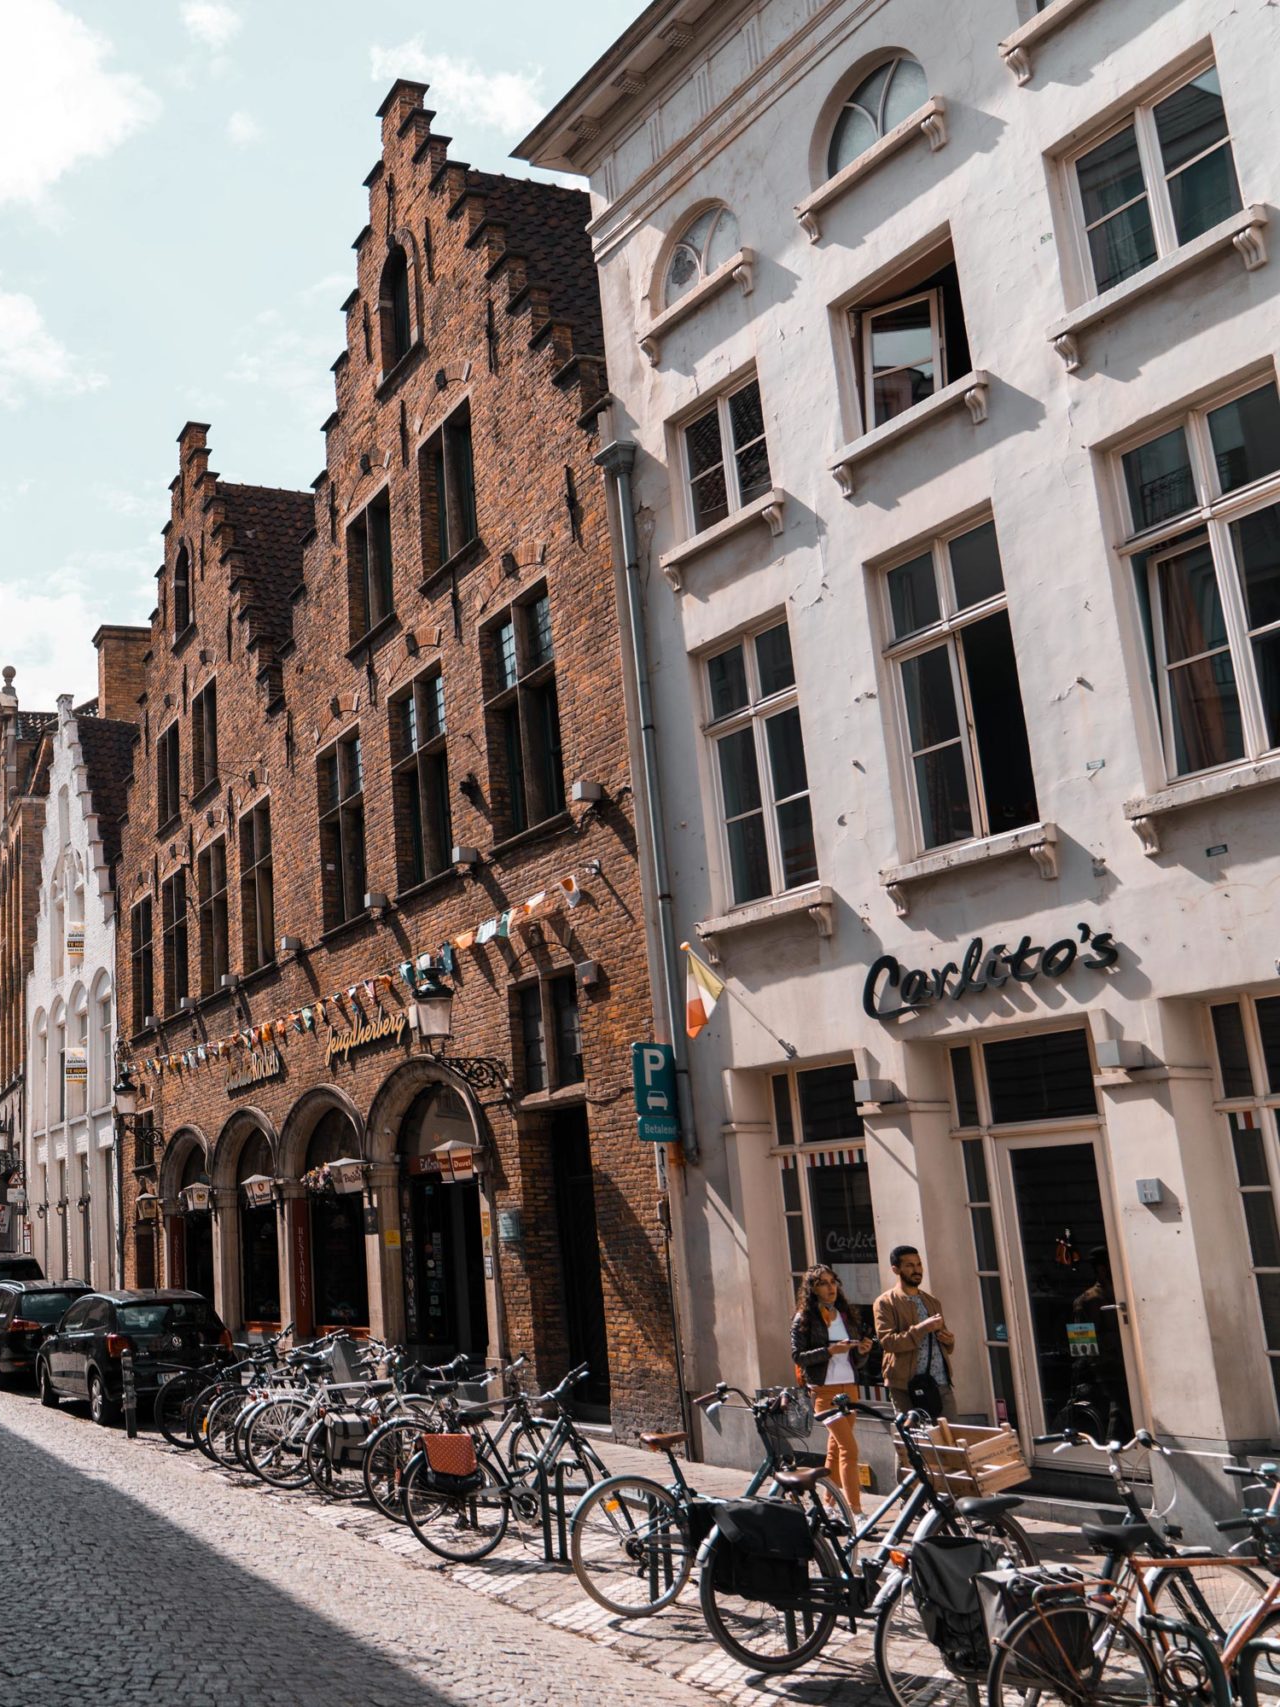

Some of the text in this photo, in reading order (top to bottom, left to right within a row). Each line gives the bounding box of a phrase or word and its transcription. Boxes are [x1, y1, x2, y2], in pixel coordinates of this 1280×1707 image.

[863, 922, 1119, 1020] Carlito's
[325, 1005, 406, 1067] Jeugdherberg
[643, 1048, 665, 1086] P
[644, 1123, 677, 1135] Betalend
[453, 1159, 471, 1168] Duvel
[826, 1230, 876, 1253] Carlit
